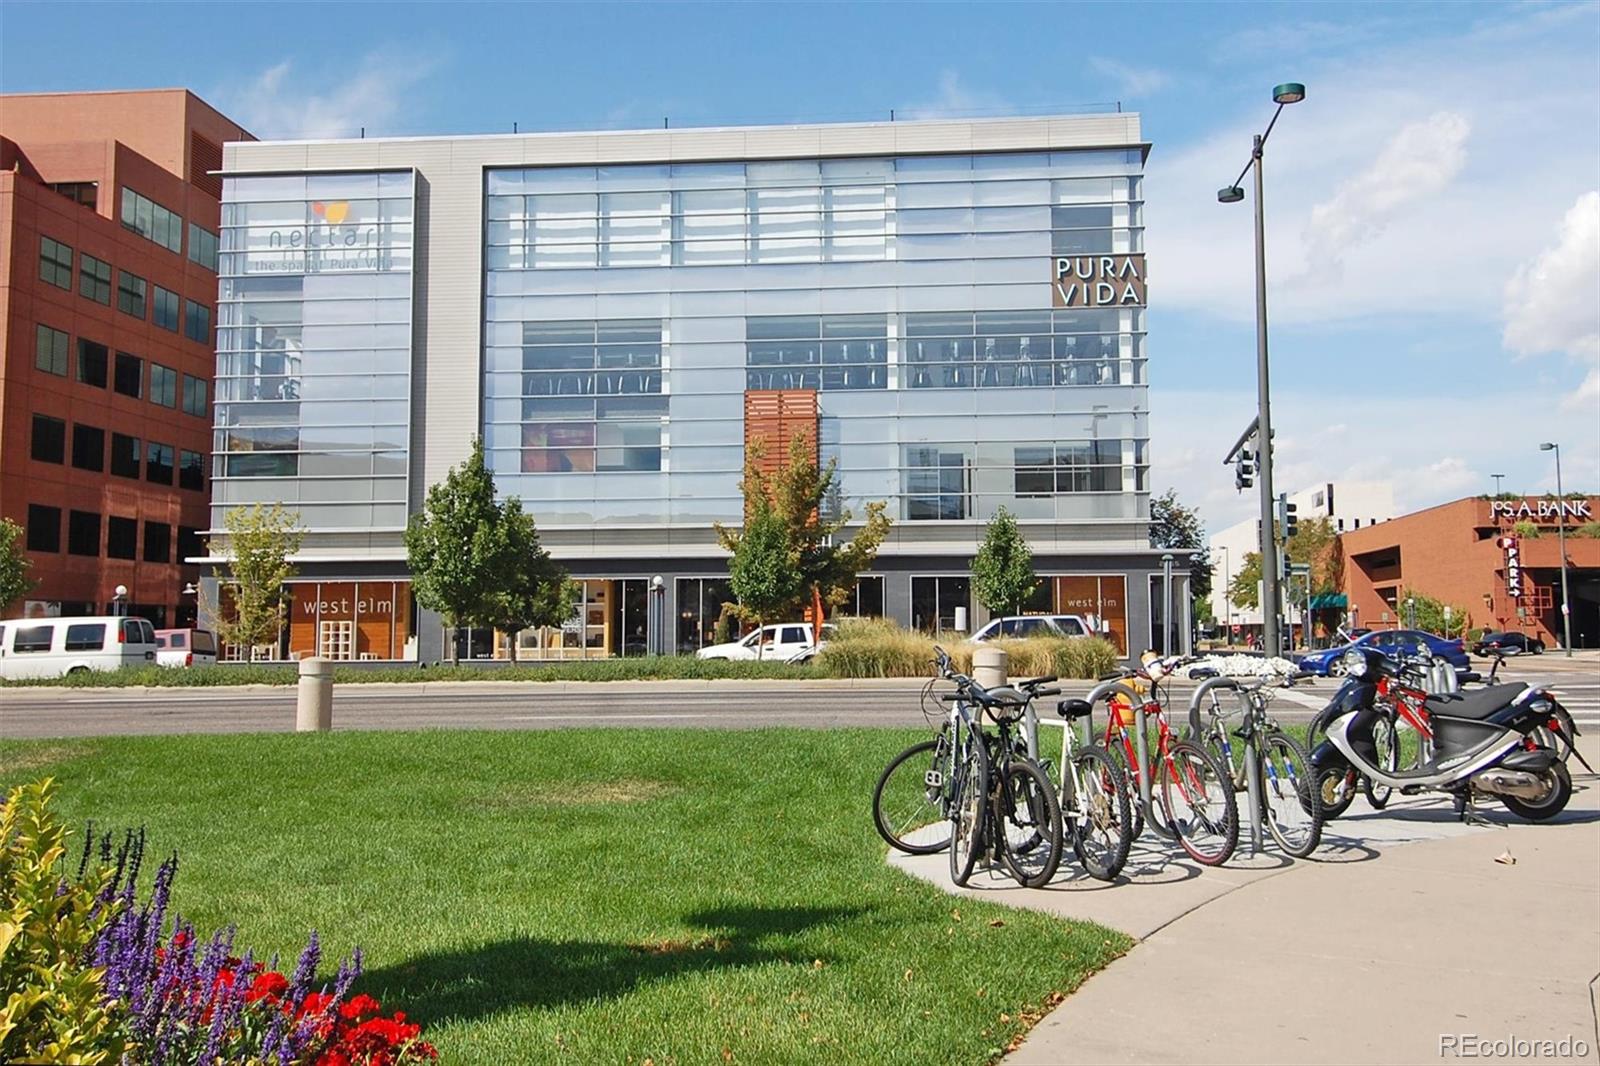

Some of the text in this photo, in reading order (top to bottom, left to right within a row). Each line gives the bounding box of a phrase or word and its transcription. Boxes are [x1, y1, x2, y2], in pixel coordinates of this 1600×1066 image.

[269, 228, 375, 248] nectar
[255, 260, 276, 271] the
[281, 261, 304, 273] spa
[330, 259, 359, 270] Pura
[1056, 256, 1139, 279] PURA
[1056, 282, 1140, 305] VIDA
[1537, 500, 1592, 517] BANK
[1508, 548, 1520, 588] PARK
[303, 597, 392, 614] west elm
[1067, 598, 1093, 607] west
